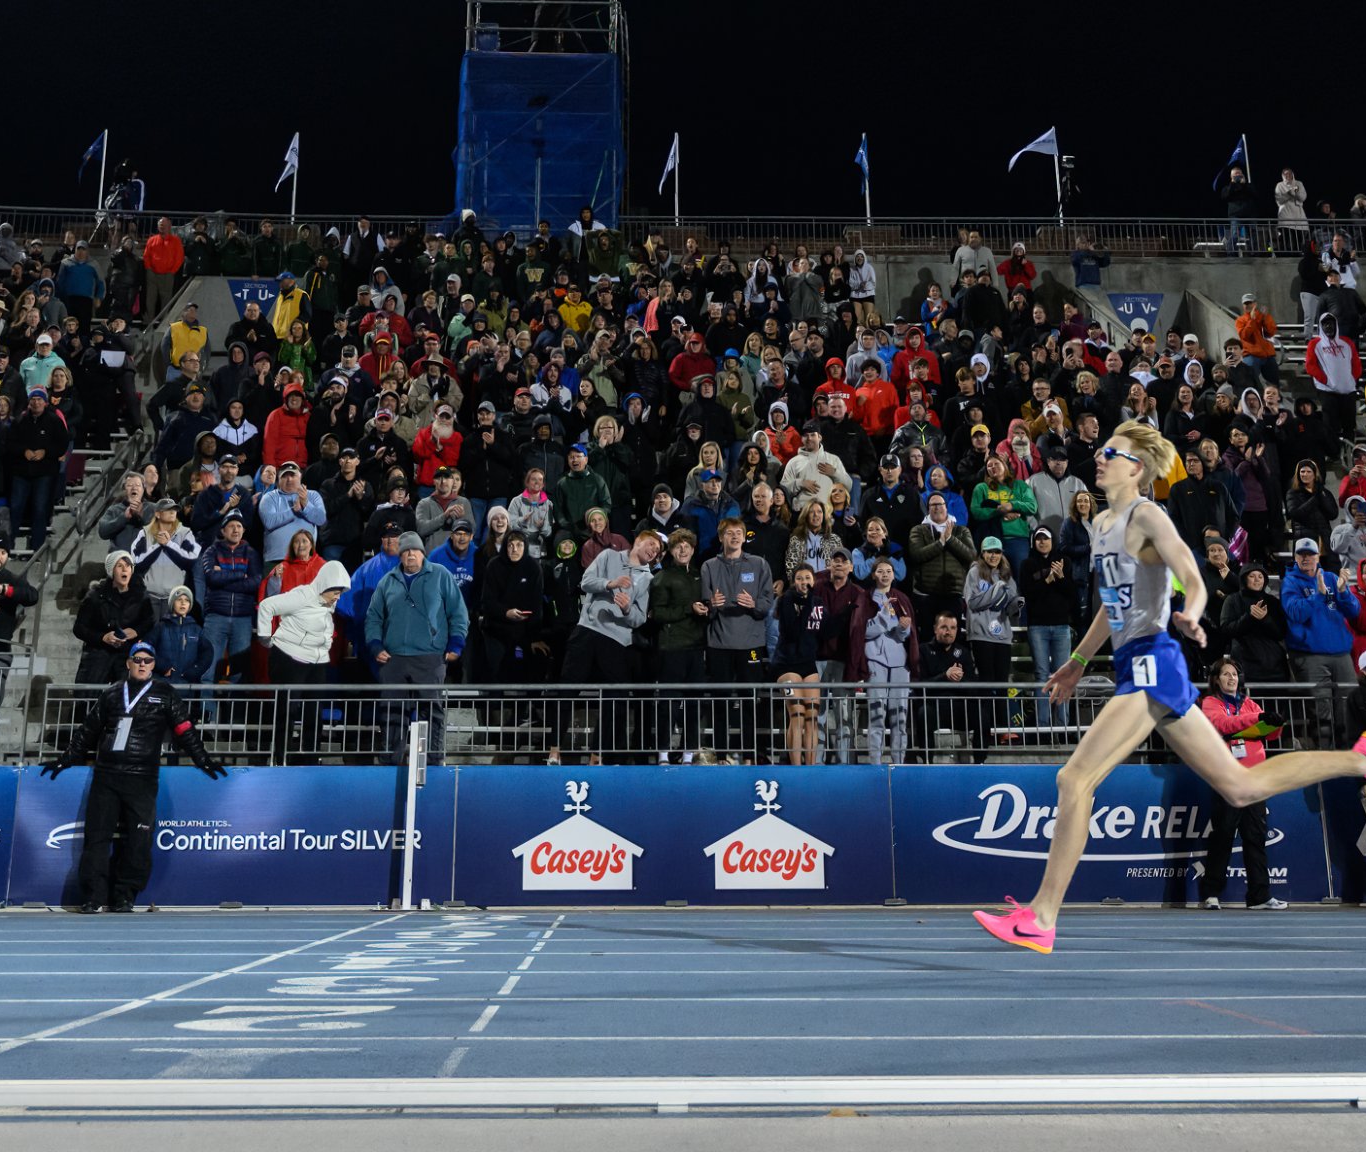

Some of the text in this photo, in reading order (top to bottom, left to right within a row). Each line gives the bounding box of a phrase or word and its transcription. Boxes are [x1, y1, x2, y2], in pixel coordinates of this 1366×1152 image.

[1140, 658, 1150, 684] 1
[156, 829, 422, 851] Continental Tour SILVER
[530, 841, 626, 882] Casey's
[722, 840, 818, 881] Casey's
[1126, 867, 1189, 879] PRESENTED BY
